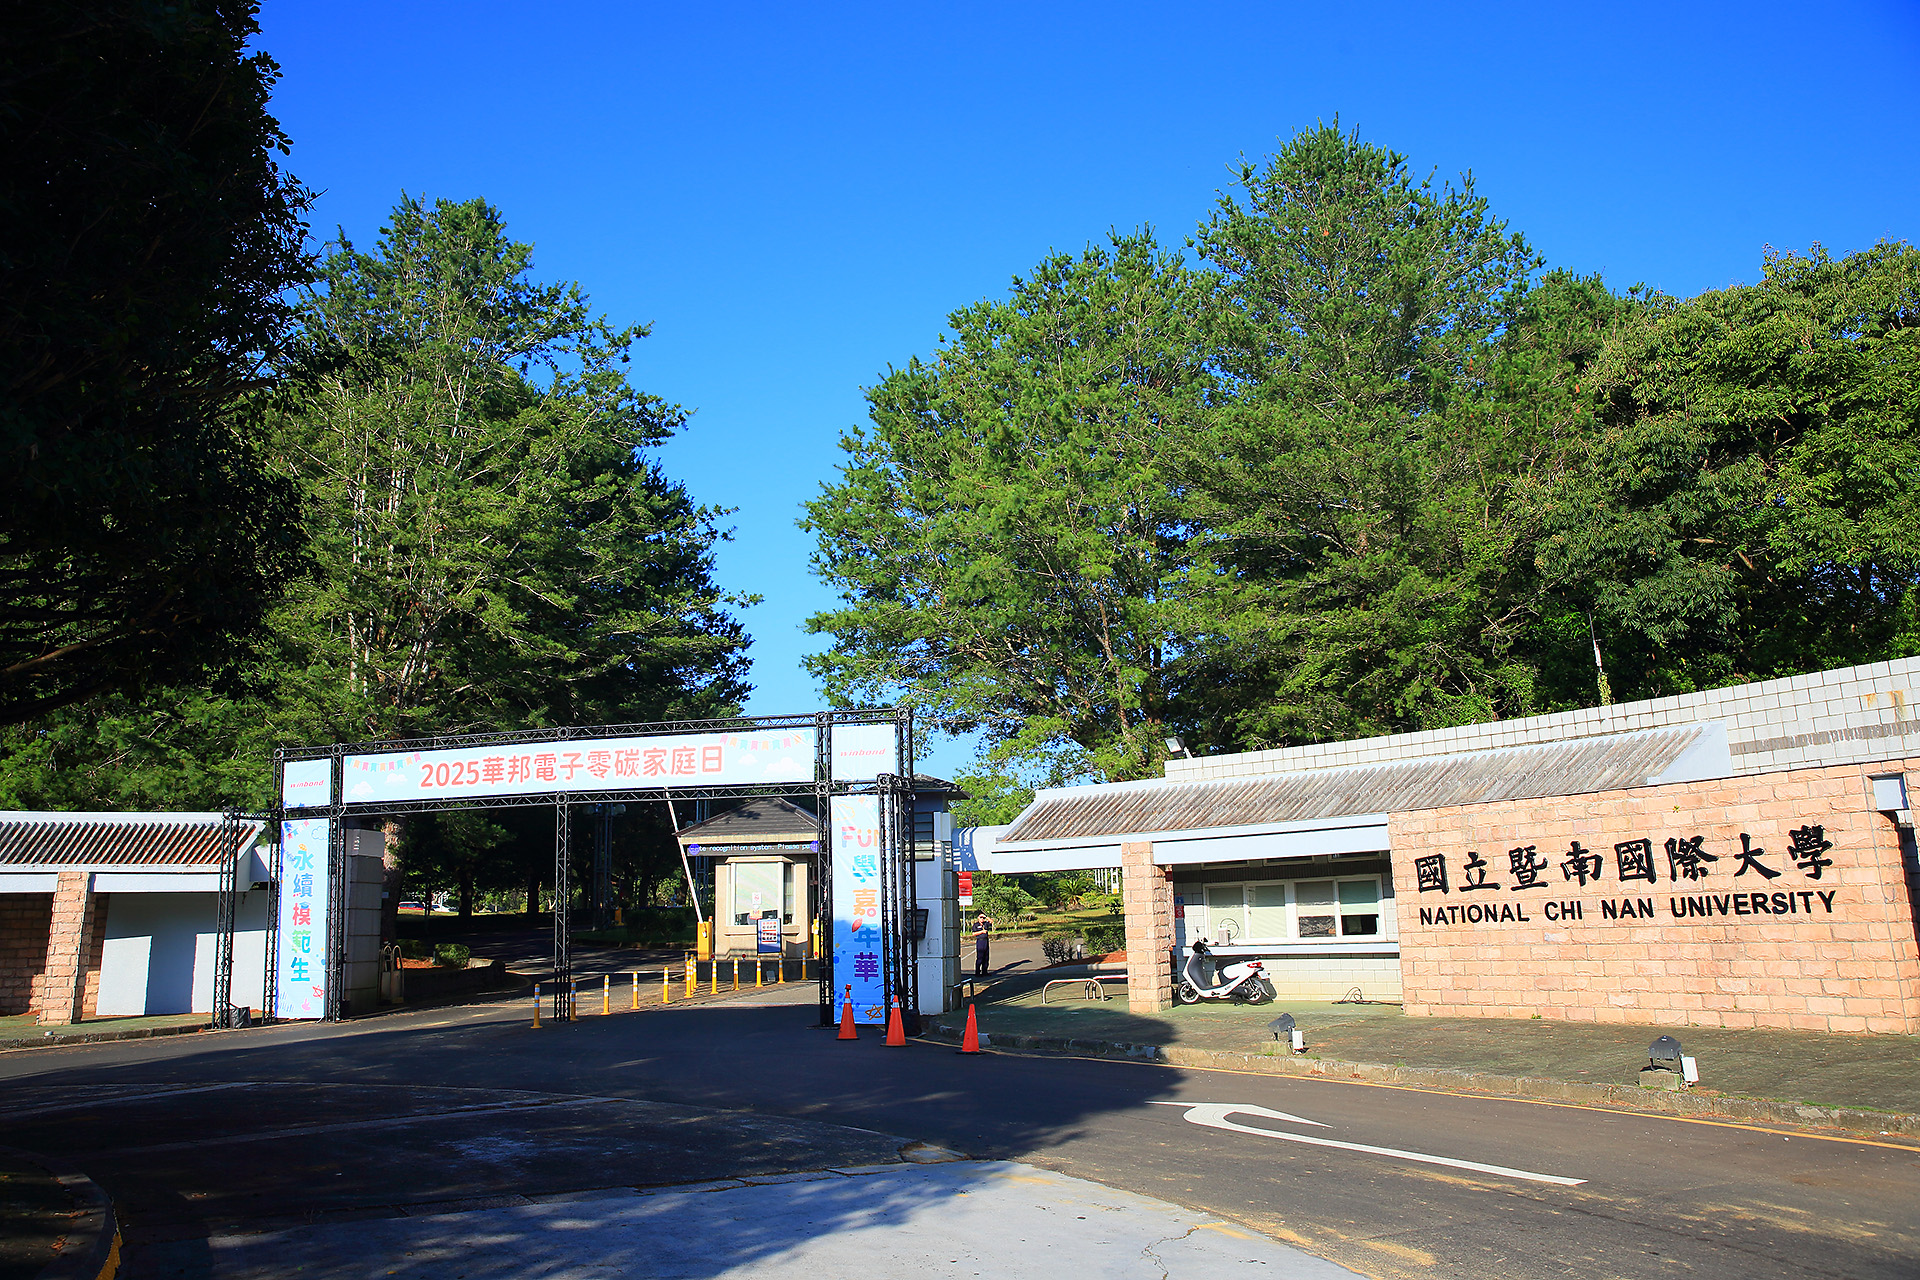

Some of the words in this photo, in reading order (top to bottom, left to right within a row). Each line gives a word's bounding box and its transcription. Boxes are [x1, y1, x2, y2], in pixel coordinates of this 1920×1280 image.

[420, 745, 723, 788] 2025華邦電子零碳家庭日
[840, 748, 886, 757] winbond
[290, 779, 325, 788] winbond
[709, 845, 748, 853] recognition
[1414, 825, 1833, 895] 國立暨南國際大學
[291, 844, 315, 983] 永續模範生
[851, 854, 880, 983] 學嘉年華
[1419, 903, 1530, 926] NATIONAL
[1544, 900, 1583, 922] CHI
[1602, 897, 1655, 920] NAN
[1670, 890, 1837, 919] UNIVERSITY
